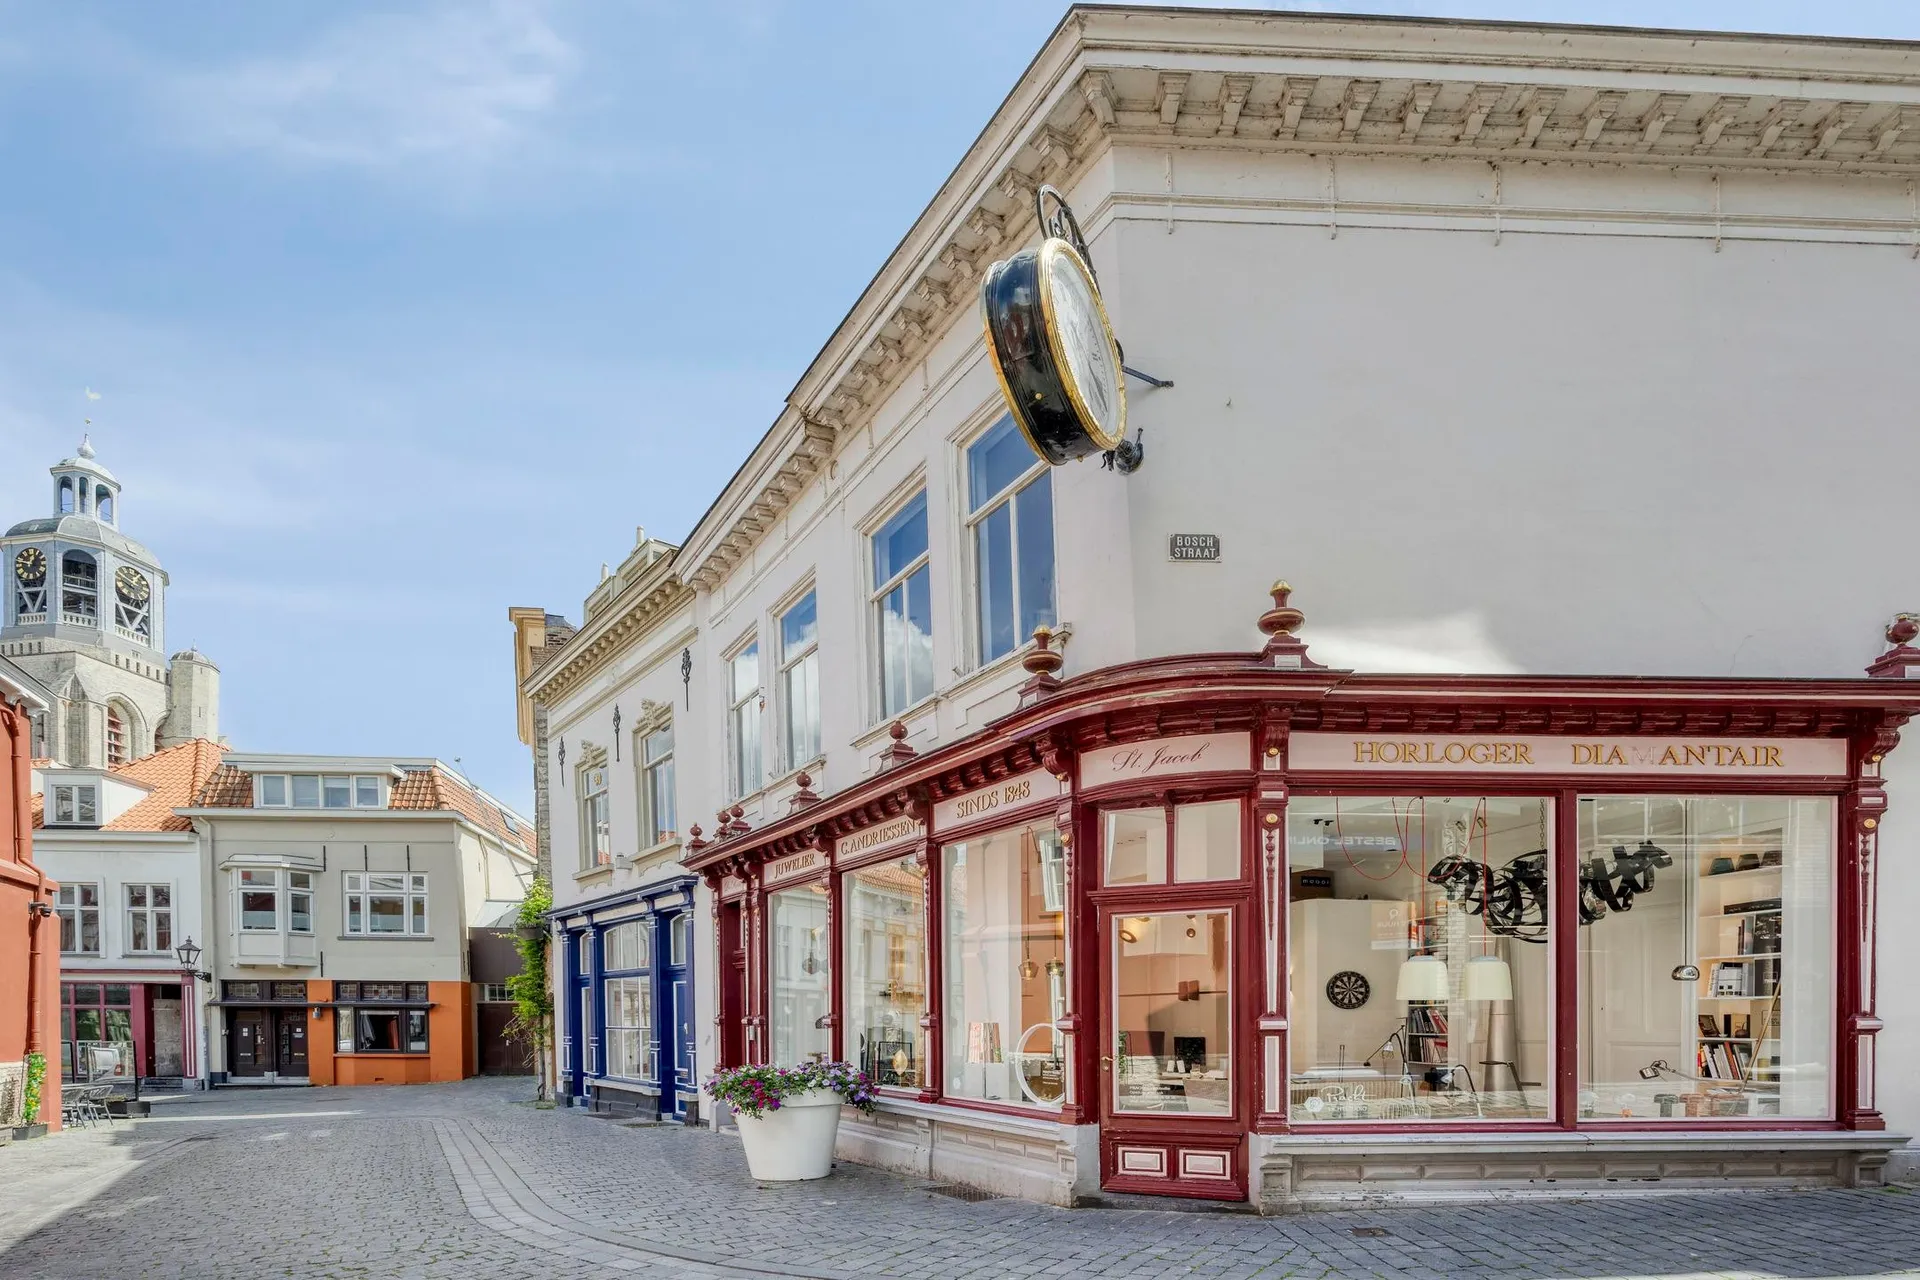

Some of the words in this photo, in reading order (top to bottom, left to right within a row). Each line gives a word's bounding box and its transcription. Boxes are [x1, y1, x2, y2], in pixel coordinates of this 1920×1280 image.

[1174, 548, 1216, 558] STRAAT
[1177, 536, 1213, 547] BOSCH
[1112, 748, 1143, 771] St.
[1142, 742, 1210, 773] Jacob
[1353, 741, 1535, 764] HORLOGER
[1571, 743, 1784, 767] DIAMANTAIR
[956, 790, 999, 818] SINDS
[1003, 780, 1031, 805] 1848
[774, 853, 815, 879] JUWELIER
